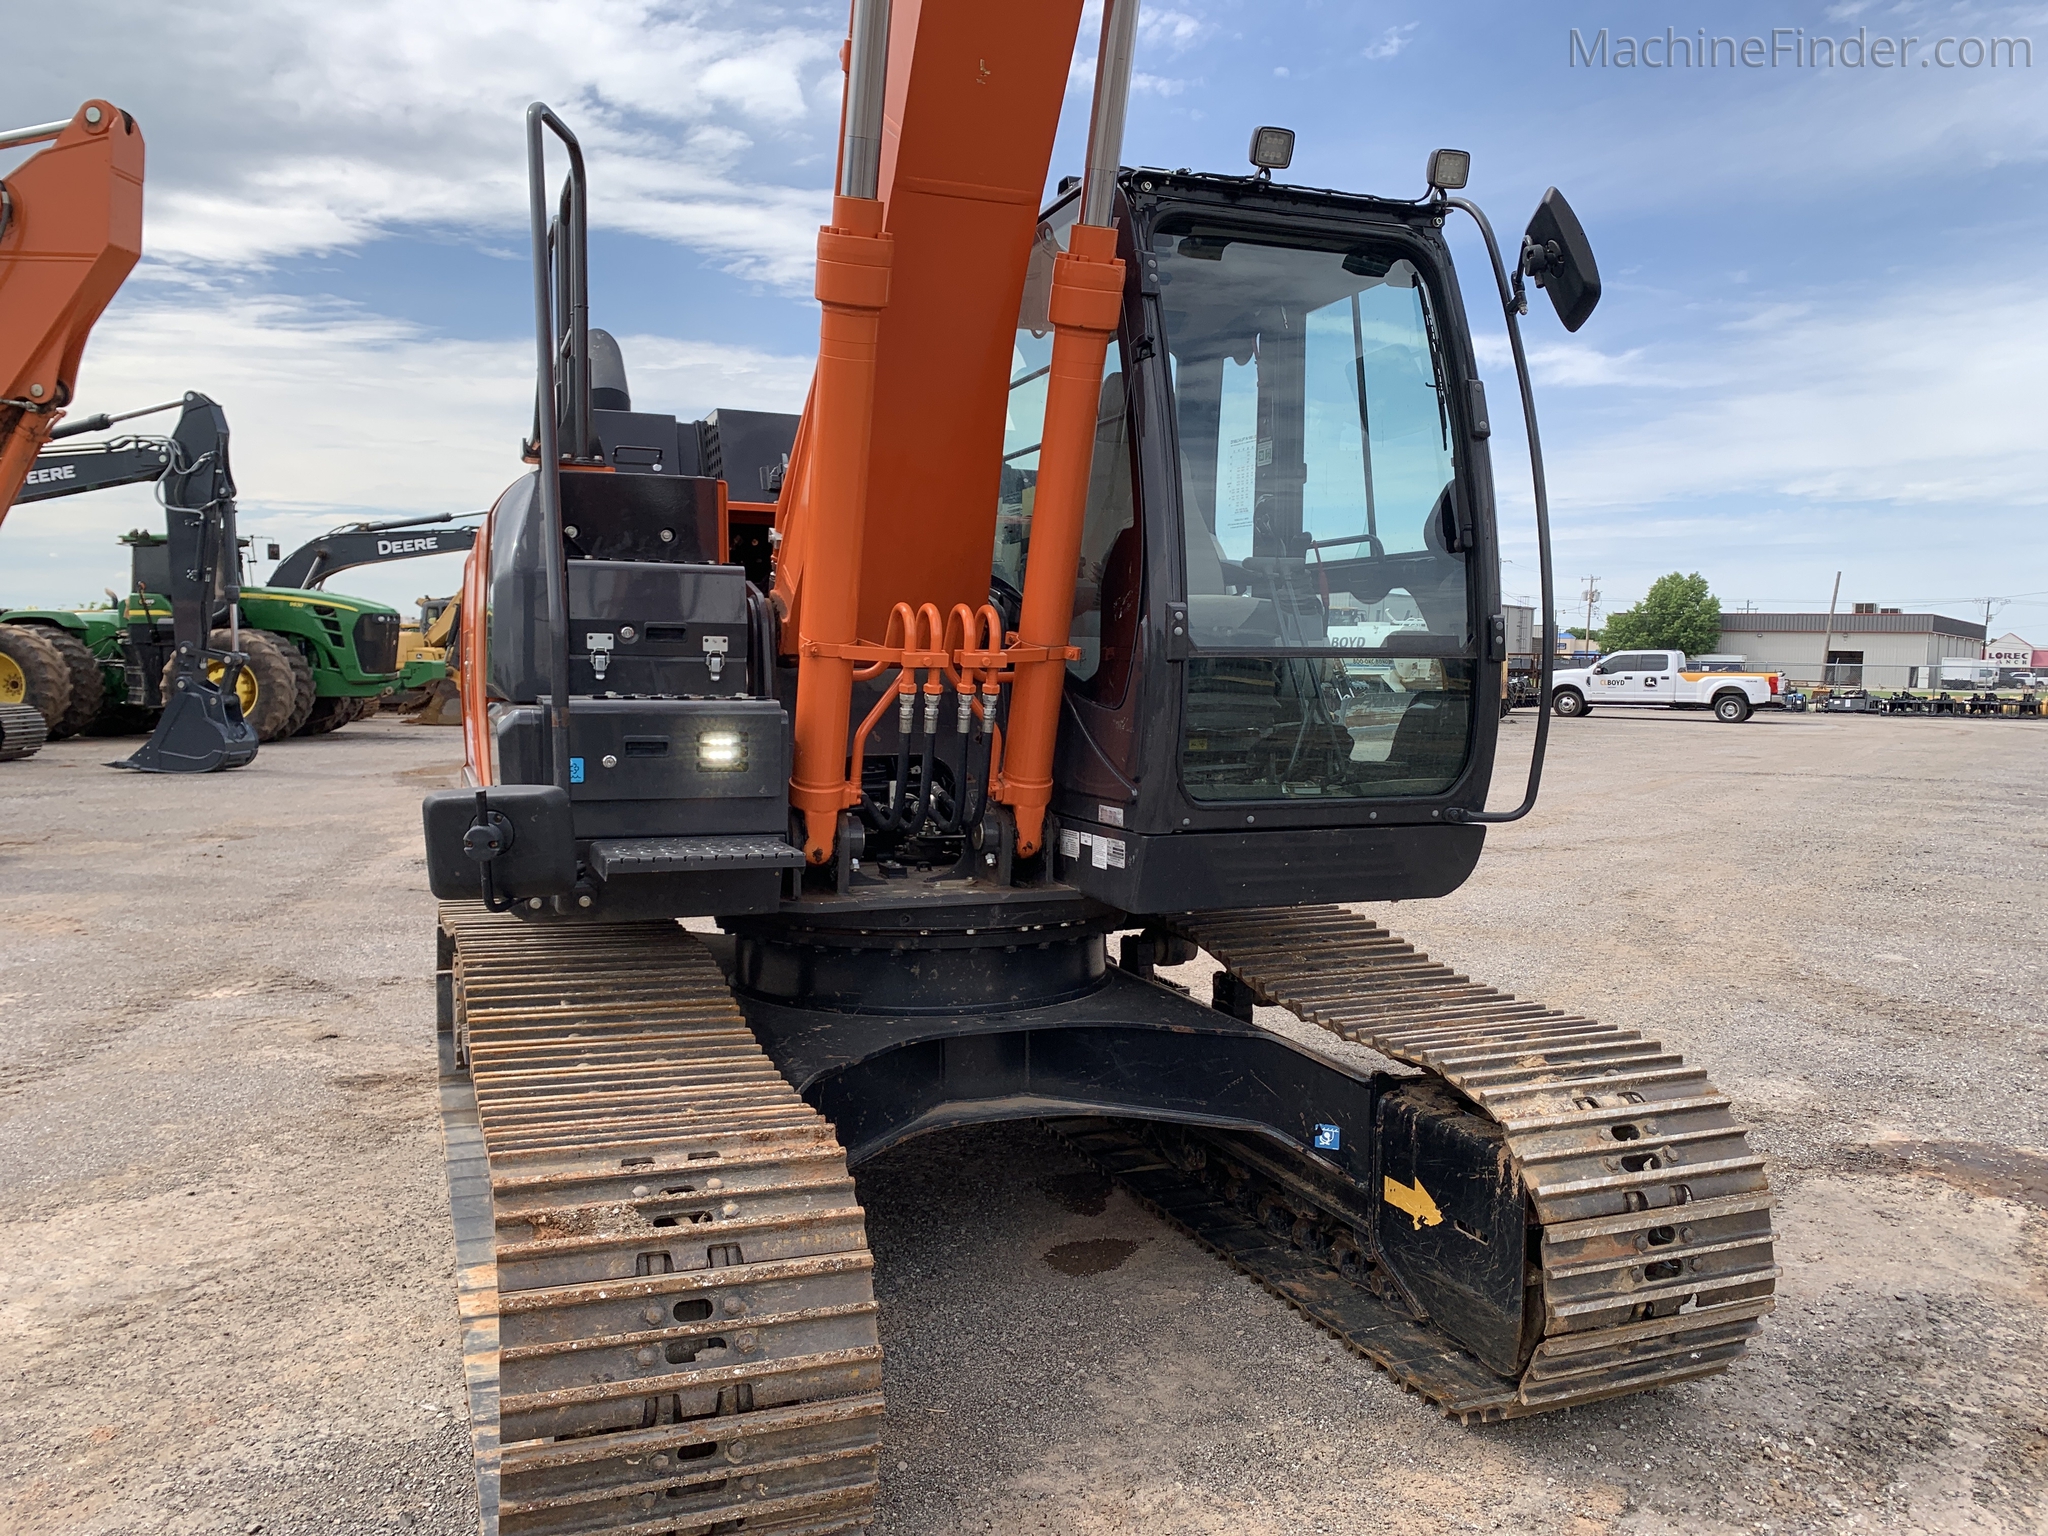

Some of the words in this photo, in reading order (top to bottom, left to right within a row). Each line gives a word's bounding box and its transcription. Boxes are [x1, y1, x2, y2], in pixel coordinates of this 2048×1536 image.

[25, 464, 76, 485] EERE
[377, 536, 438, 555] DEERE
[1331, 636, 1366, 648] BOYD
[1988, 652, 2029, 660] LOREC
